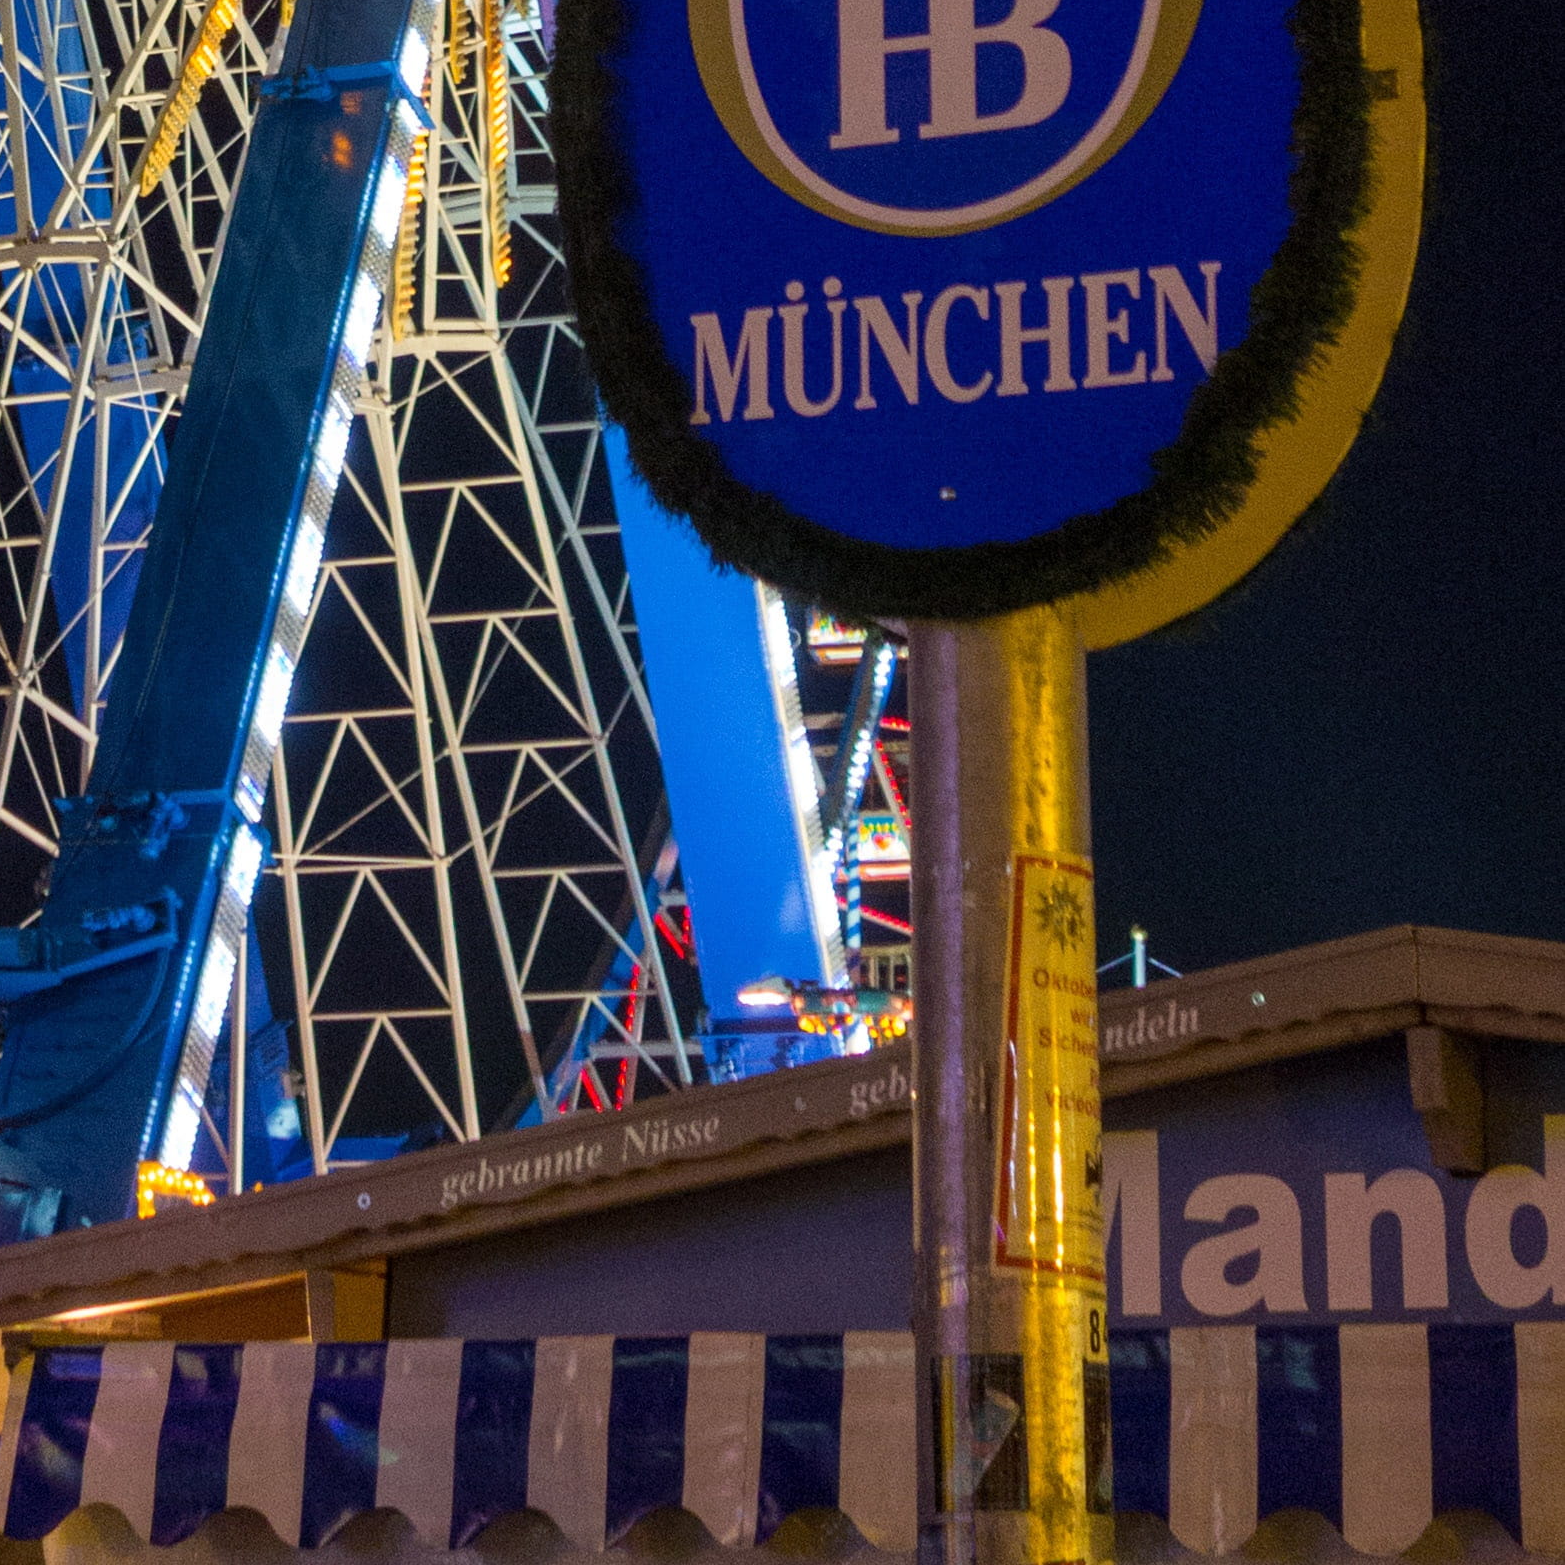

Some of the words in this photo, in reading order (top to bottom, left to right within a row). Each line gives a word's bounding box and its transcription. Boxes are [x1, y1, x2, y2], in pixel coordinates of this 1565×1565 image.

[689, 260, 1222, 425] MÜNCHEN
[440, 1142, 603, 1209] gebrannte
[621, 1116, 720, 1162] Nüsse
